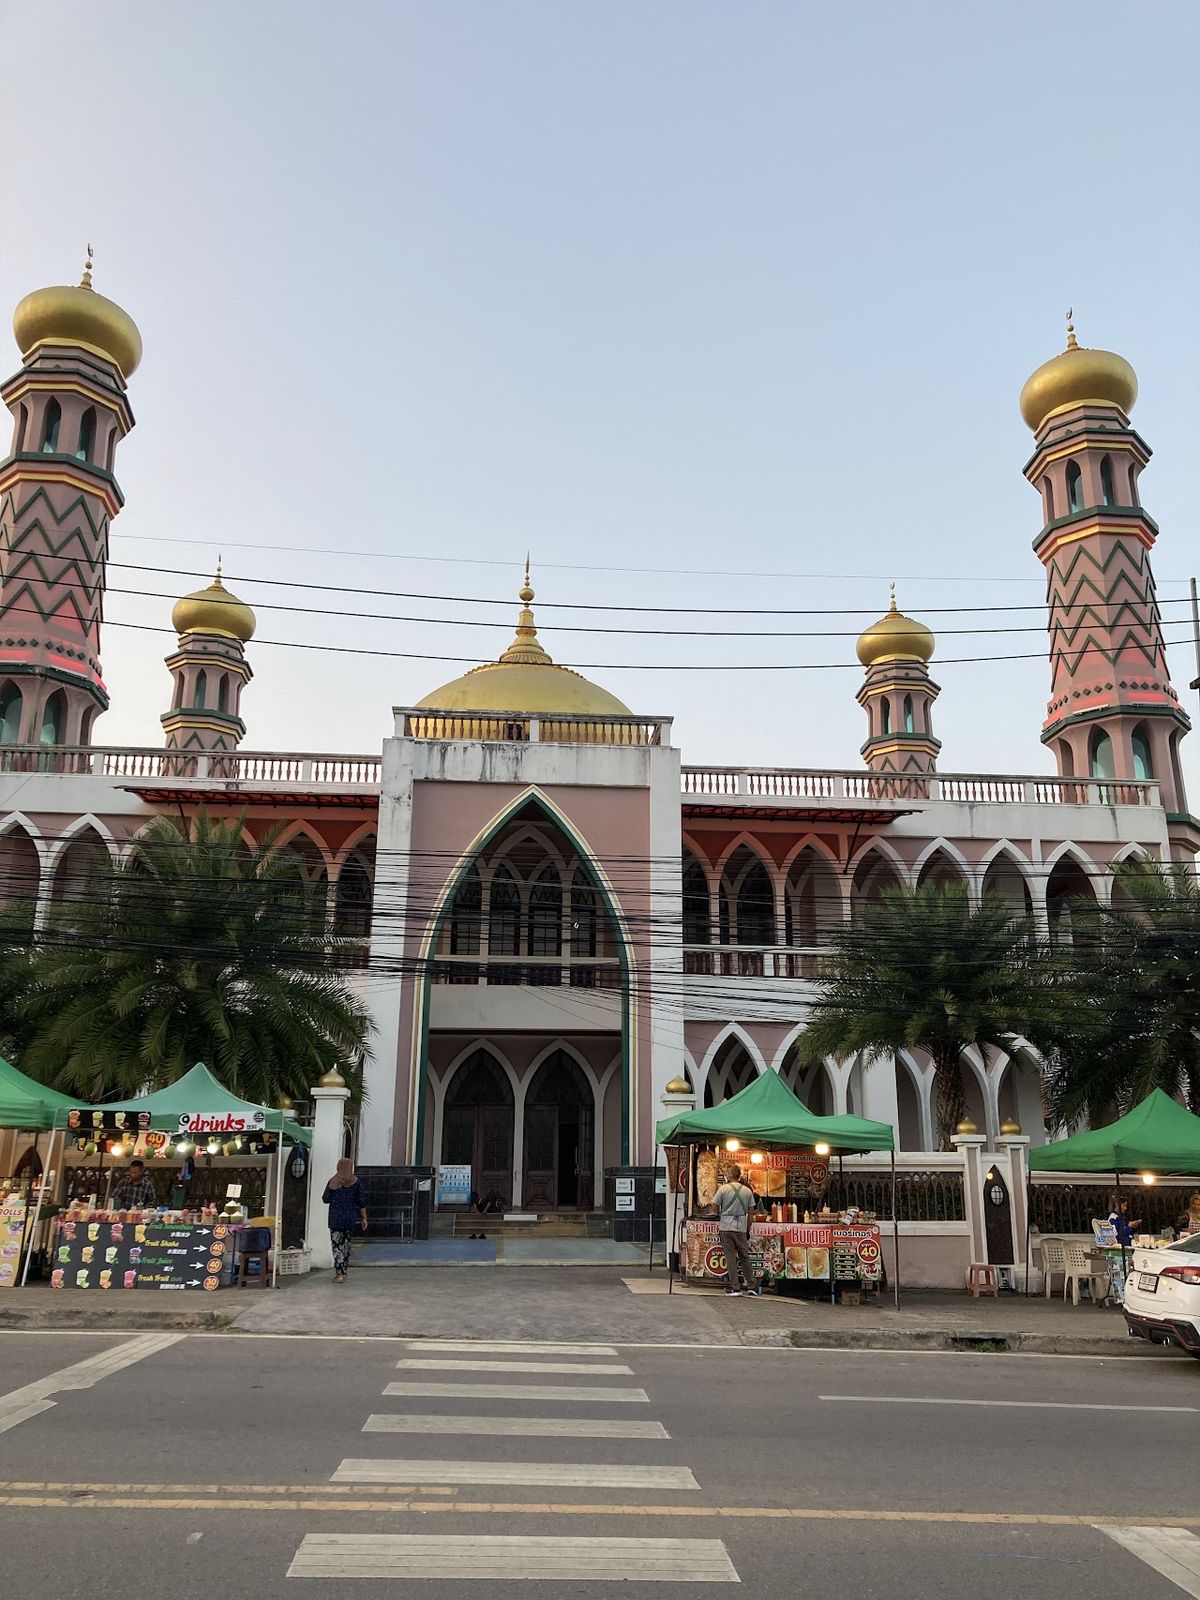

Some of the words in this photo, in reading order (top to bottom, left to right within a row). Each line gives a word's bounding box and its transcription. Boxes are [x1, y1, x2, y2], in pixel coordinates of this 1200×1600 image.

[188, 1113, 246, 1132] drinks
[148, 1133, 163, 1144] 40
[791, 1226, 831, 1248] Burger
[861, 1247, 878, 1257] 40
[710, 1255, 728, 1269] 60
